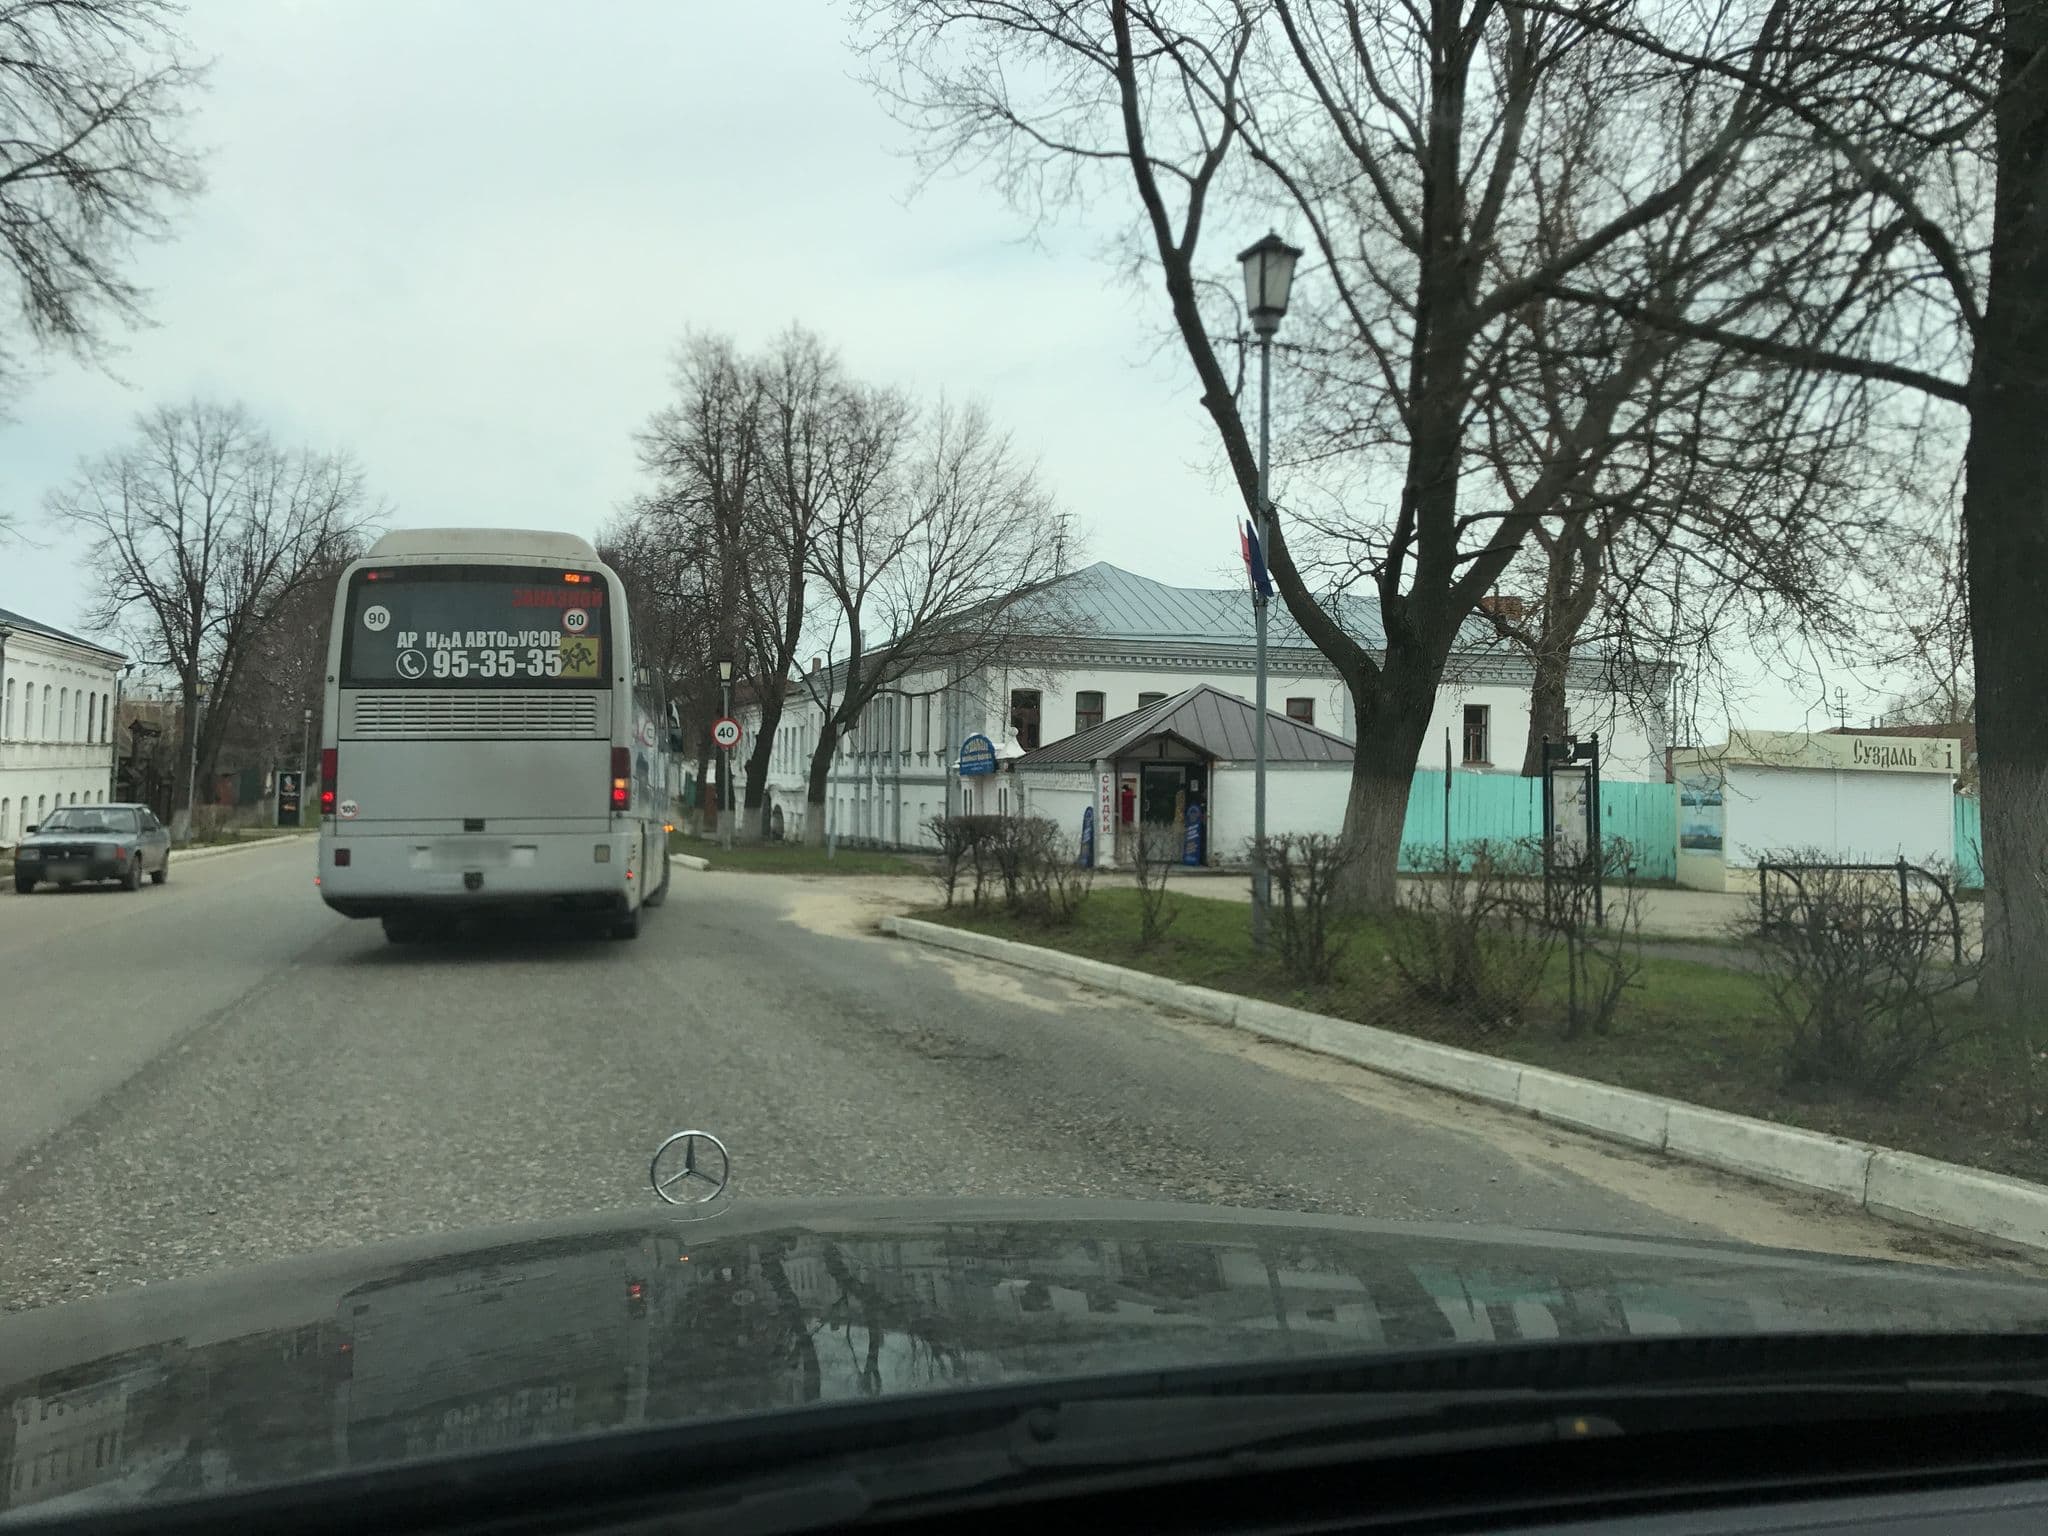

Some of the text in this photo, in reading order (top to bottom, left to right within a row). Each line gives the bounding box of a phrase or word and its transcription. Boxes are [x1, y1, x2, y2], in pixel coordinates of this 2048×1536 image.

[368, 612, 386, 625] 90
[567, 614, 584, 626] 60
[396, 631, 462, 650] АРНДА
[433, 649, 562, 677] 95-35-35
[717, 726, 734, 738] 40
[1853, 738, 1917, 769] Суздаль
[1101, 775, 1111, 833] СКИДКИ
